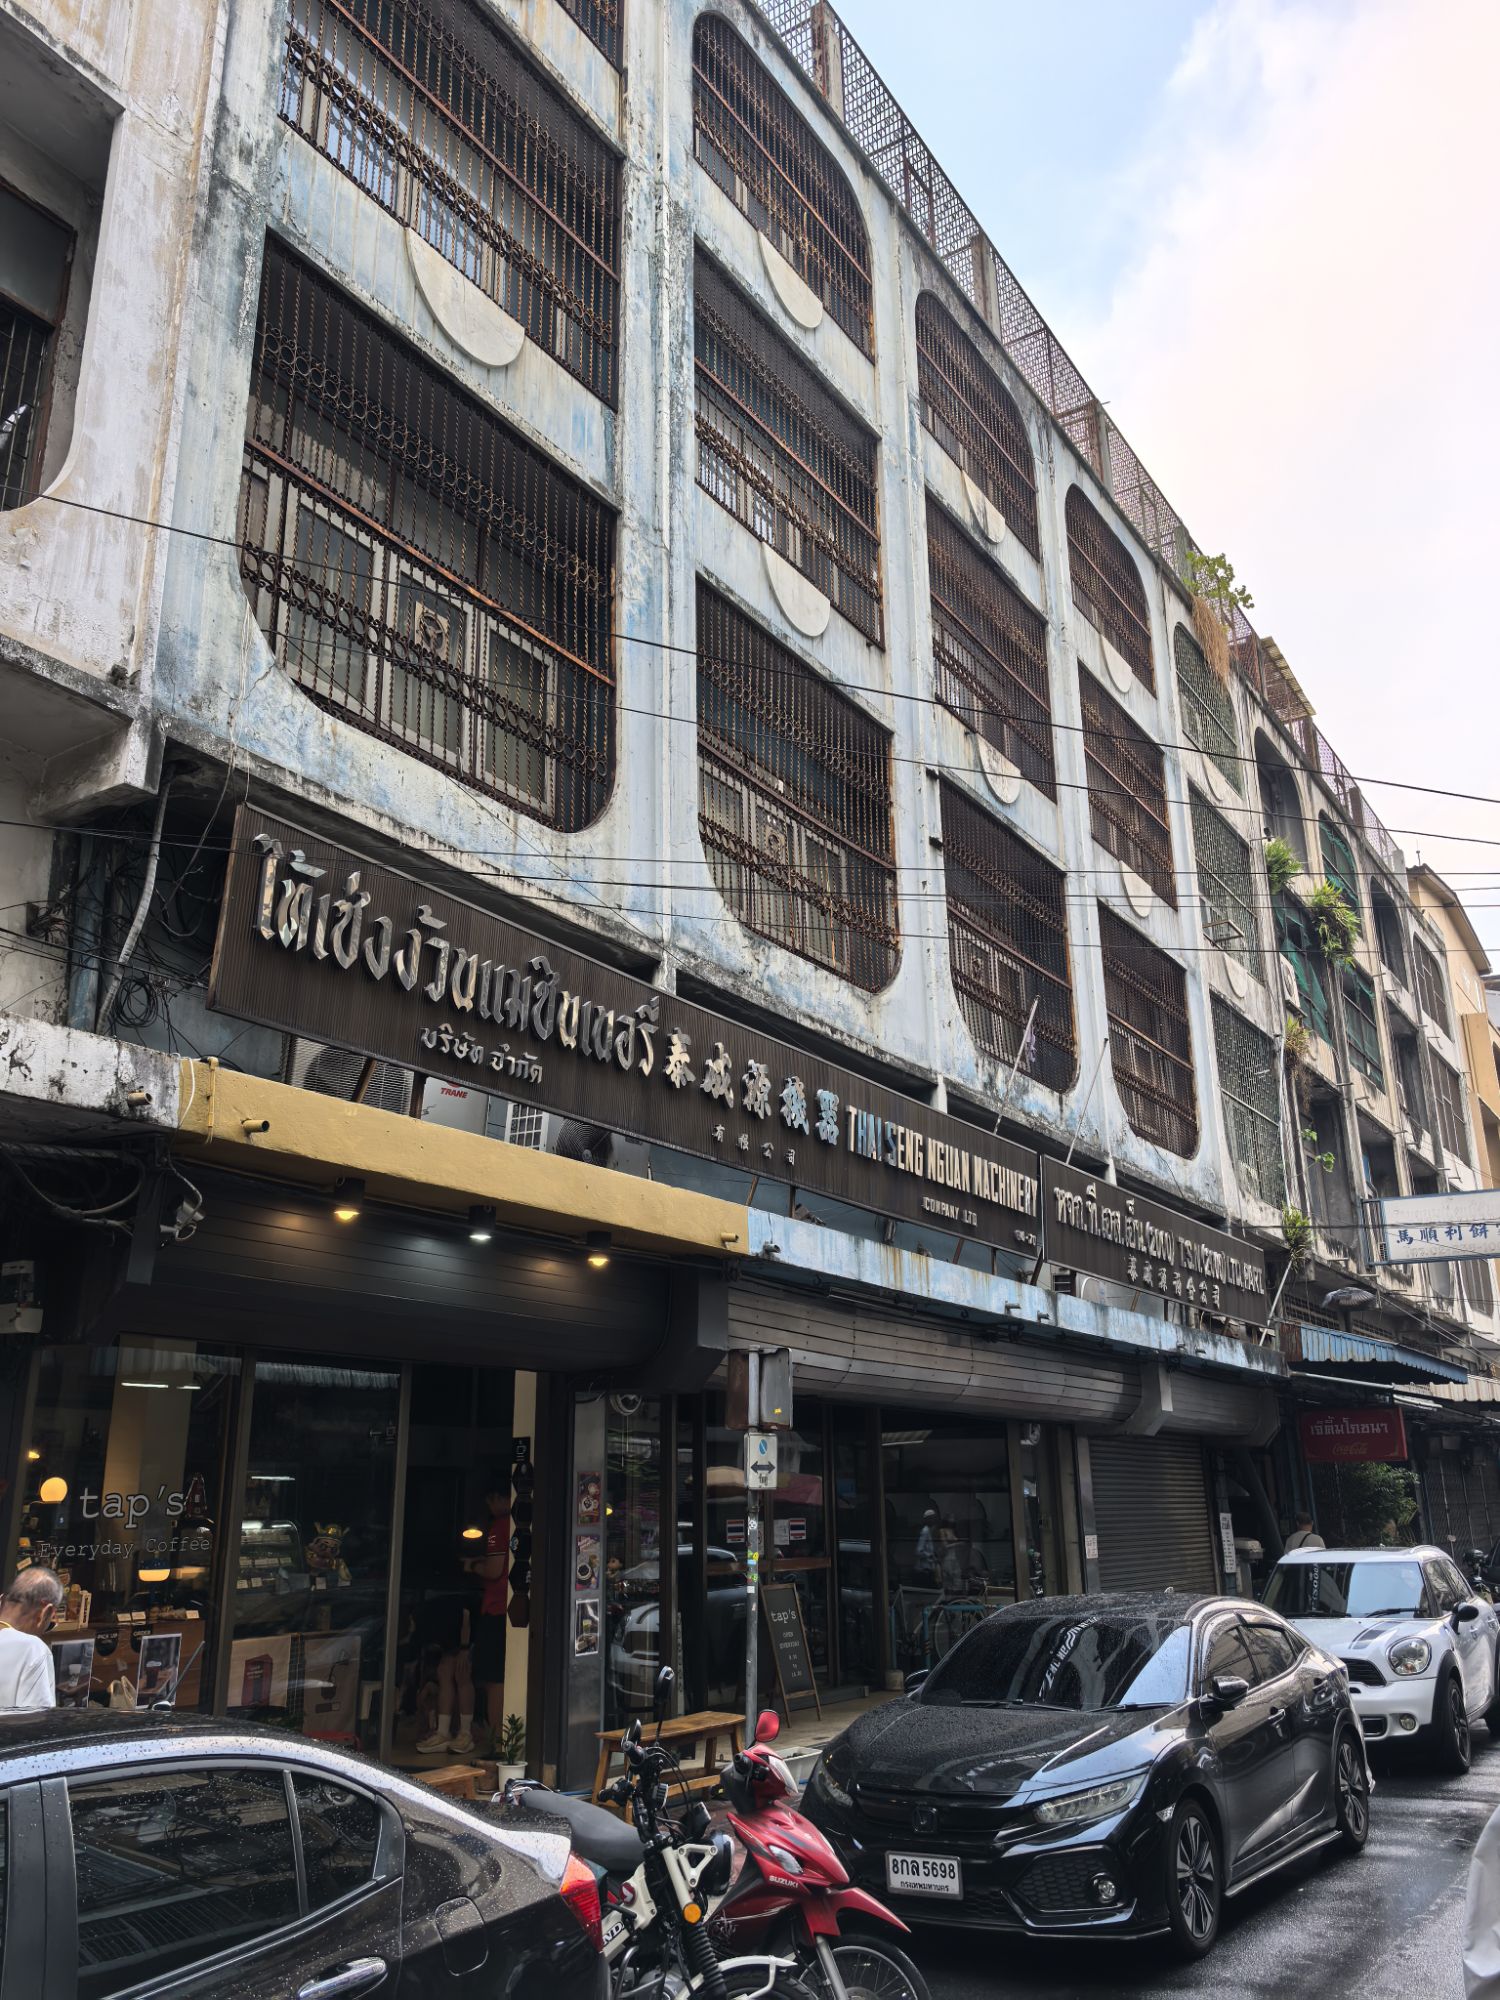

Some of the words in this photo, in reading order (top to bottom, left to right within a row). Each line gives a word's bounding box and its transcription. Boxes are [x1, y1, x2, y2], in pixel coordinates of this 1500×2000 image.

[420, 1023, 484, 1065] บริษัท
[489, 1043, 543, 1083] จำกัด
[440, 1087, 468, 1099] TRANE
[712, 1124, 796, 1166] 有限公司
[846, 1105, 882, 1162] THAI
[884, 1120, 923, 1177] SENG
[927, 1137, 970, 1193] NGUAN
[973, 1154, 1038, 1217] MACHINERY
[923, 1197, 959, 1220] COMPANY
[1397, 1223, 1500, 1245] 馬順利餅
[80, 1486, 186, 1529] tap's
[40, 1540, 134, 1561] Everyday
[147, 1537, 211, 1554] Coffee
[771, 1609, 797, 1623] tap's
[892, 1858, 920, 1876] 8กล
[923, 1861, 955, 1879] 5698
[769, 1875, 799, 1888] SUZUKI
